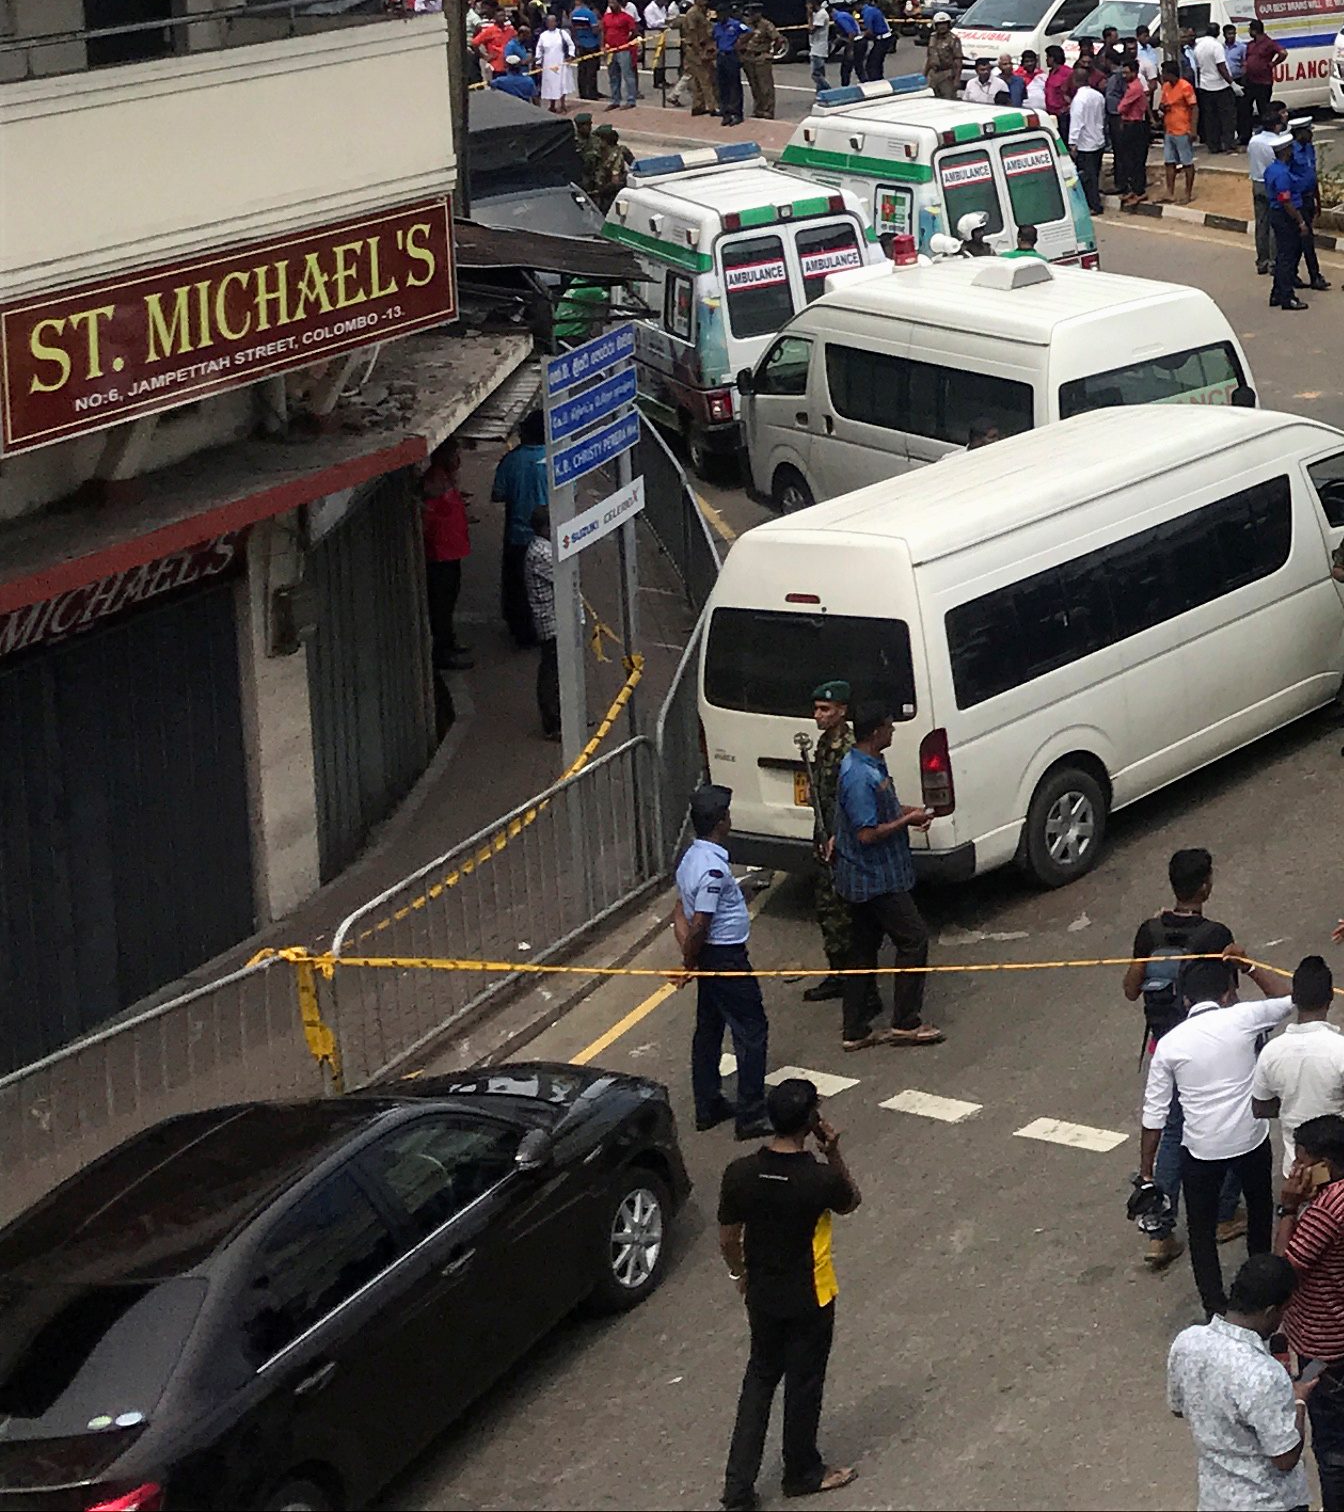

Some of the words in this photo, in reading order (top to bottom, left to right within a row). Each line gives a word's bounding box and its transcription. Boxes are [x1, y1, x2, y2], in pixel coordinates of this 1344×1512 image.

[1005, 152, 1051, 172] AMBULANCE
[944, 164, 990, 186] AMBULANCE
[804, 251, 860, 274] AMBULANCE
[728, 265, 785, 289] AMBULANCE
[28, 304, 125, 396] ST.
[143, 222, 438, 364] MICHAEL'S
[75, 388, 124, 413] NO:6,
[127, 355, 231, 399] JAMPETTAH
[233, 335, 300, 368] STREET,
[301, 312, 379, 347] COLOMBO
[571, 519, 600, 544] SUZUKI
